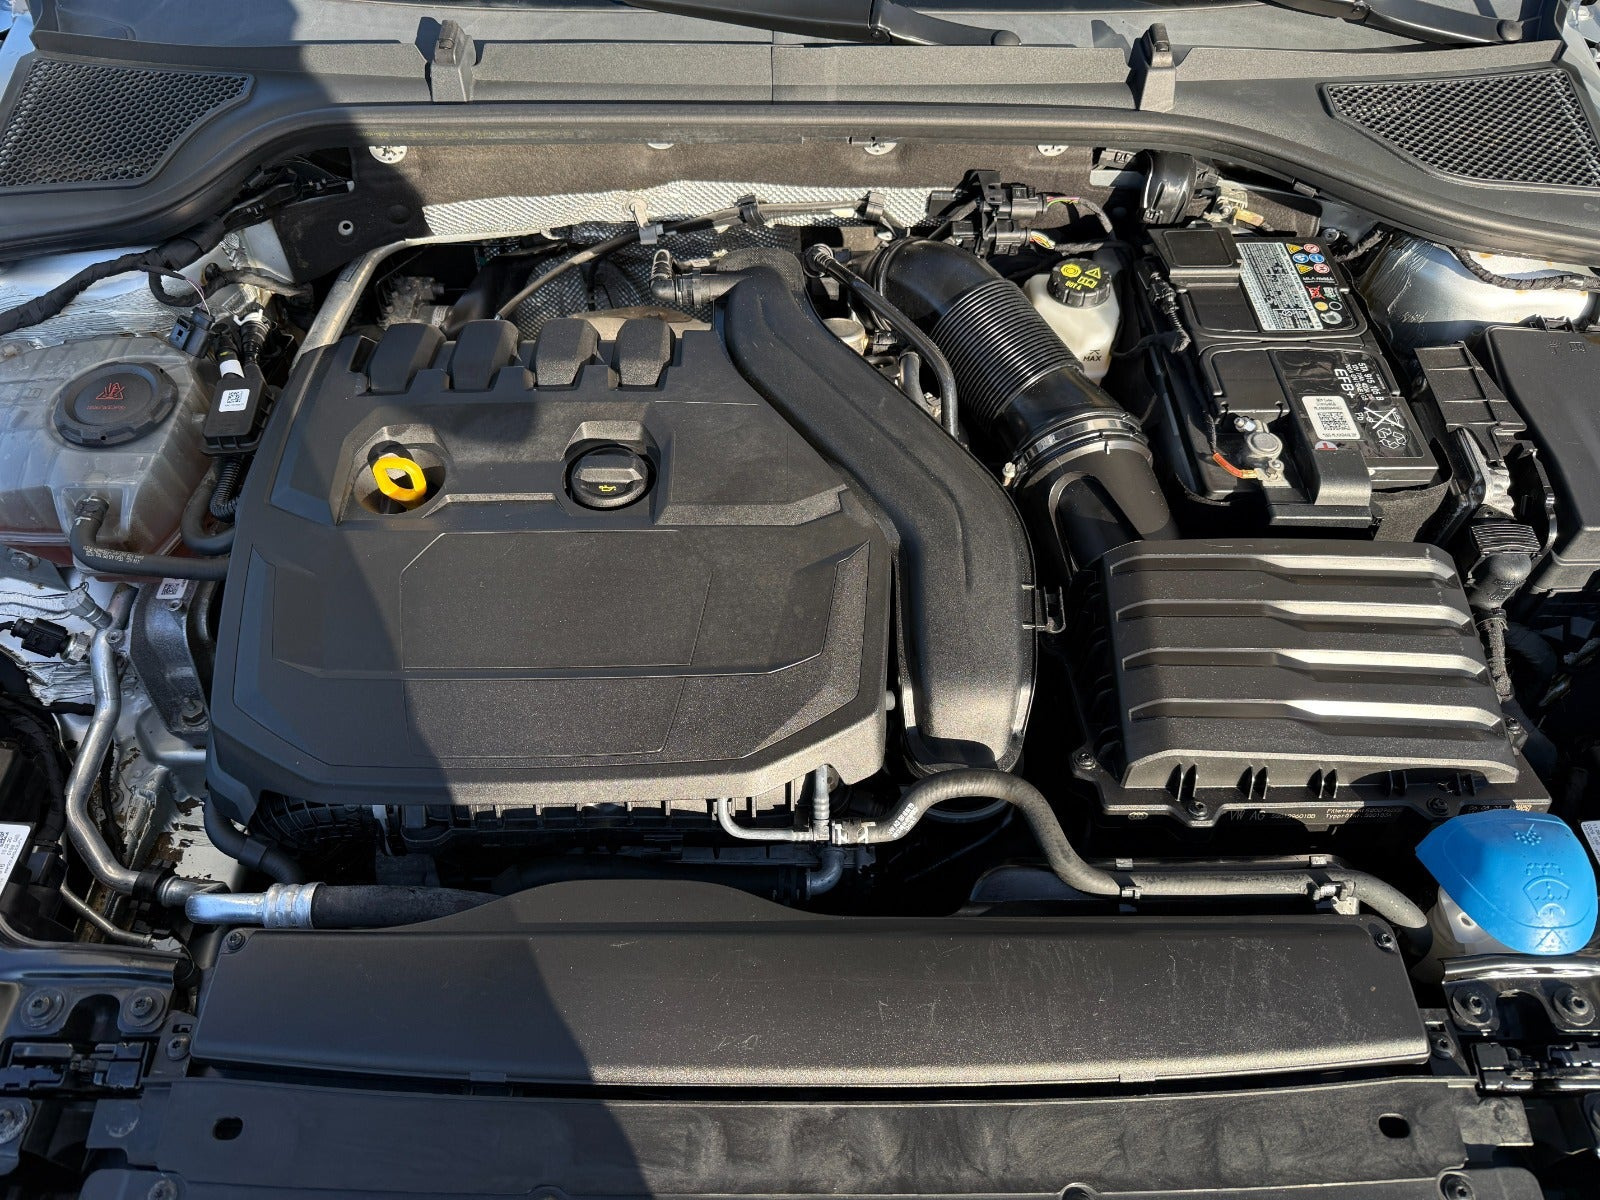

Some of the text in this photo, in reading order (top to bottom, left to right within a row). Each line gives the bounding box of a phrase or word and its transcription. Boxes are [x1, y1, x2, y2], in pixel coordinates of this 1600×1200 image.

[1334, 368, 1356, 399] EFB+
[1364, 373, 1375, 384] 915
[1230, 810, 1245, 821] VW
[1249, 810, 1266, 821] AG
